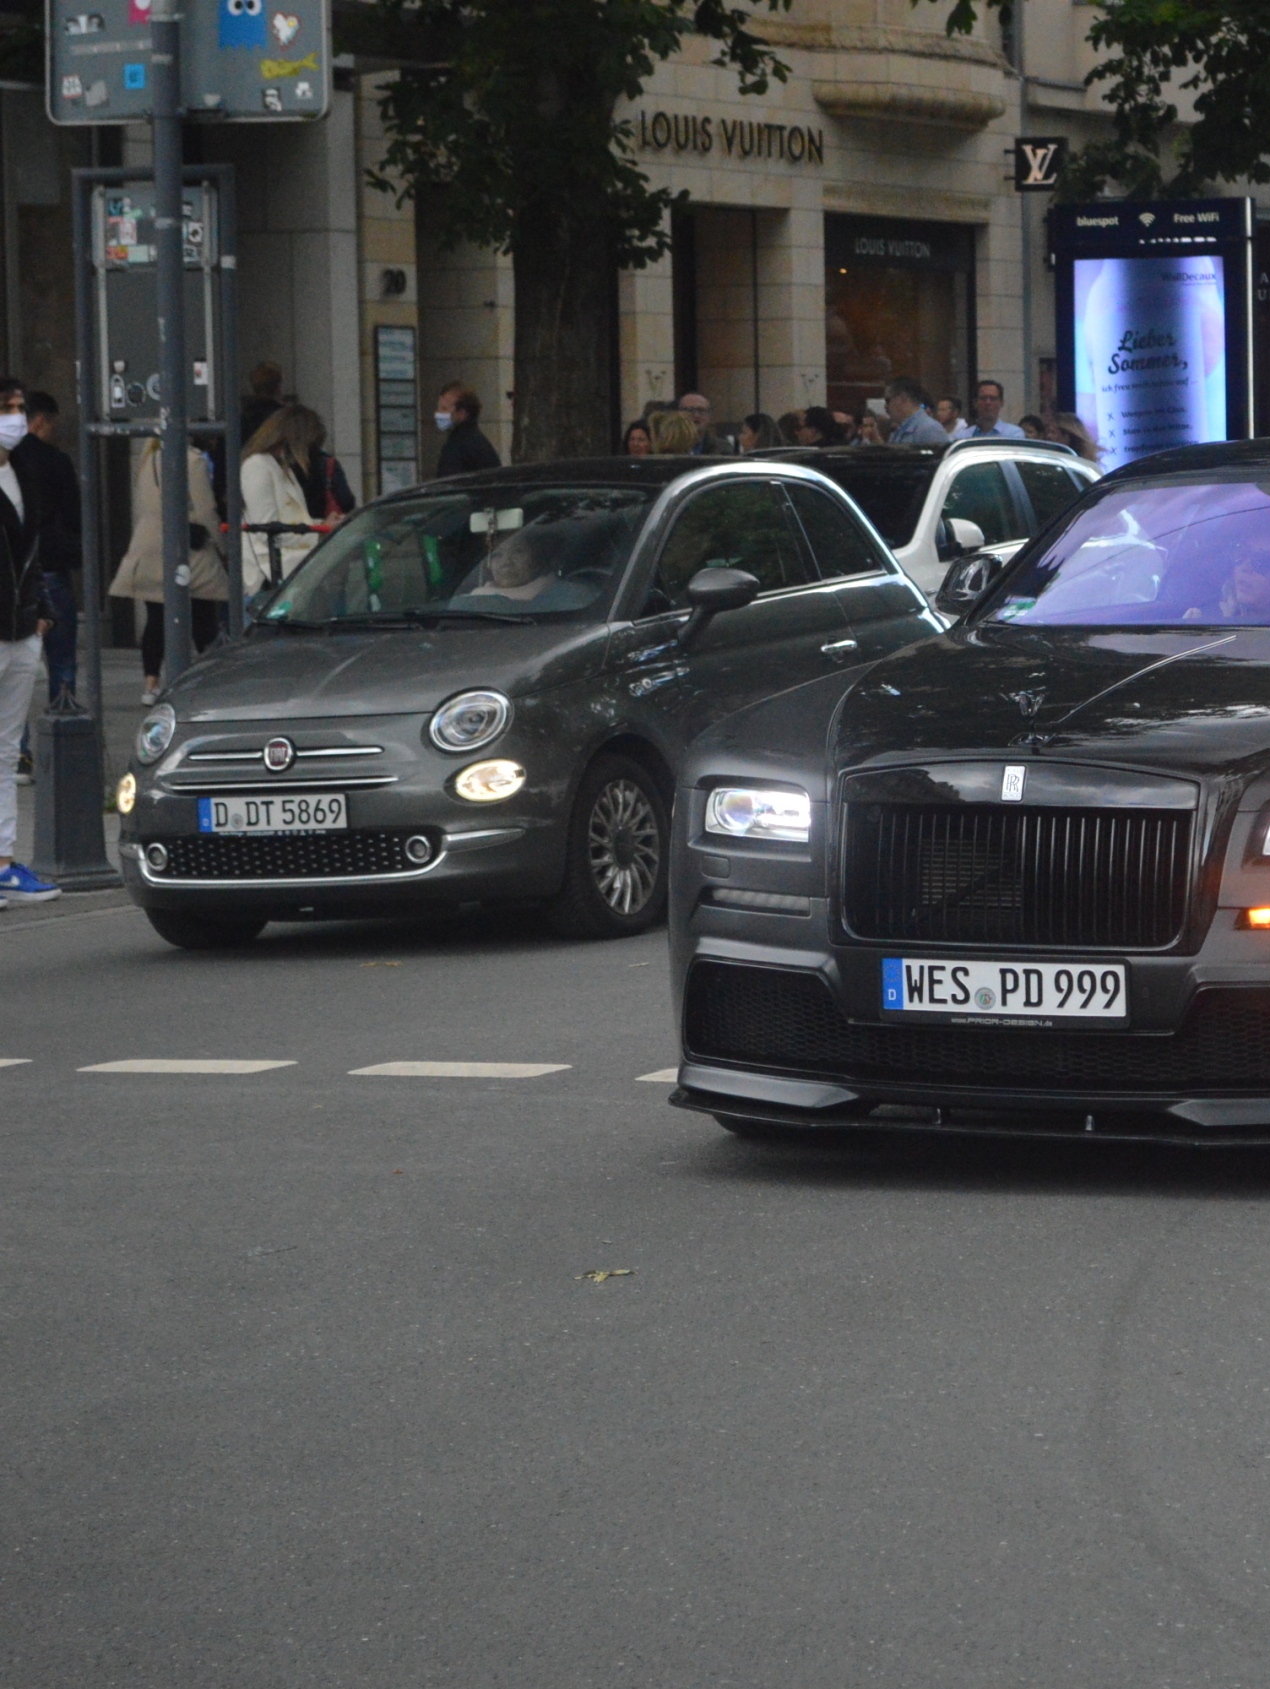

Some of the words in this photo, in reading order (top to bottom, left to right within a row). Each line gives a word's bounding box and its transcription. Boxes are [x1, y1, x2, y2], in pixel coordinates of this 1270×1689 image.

[640, 110, 713, 153] LOUIS
[721, 118, 824, 165] VUITTON
[1076, 215, 1119, 227] bluespot
[1173, 213, 1195, 223] Free
[1197, 211, 1220, 222] WiFi
[855, 237, 886, 256] LOUIS
[888, 240, 931, 259] VUITTON
[383, 268, 406, 295] 20
[1117, 330, 1176, 353] Lieber
[214, 801, 229, 828] D
[245, 801, 274, 827] DT
[282, 799, 343, 826] 5869
[888, 989, 896, 1001] D
[905, 964, 971, 1006] WES
[999, 968, 1043, 1008] PD
[1054, 969, 1121, 1010] 999
